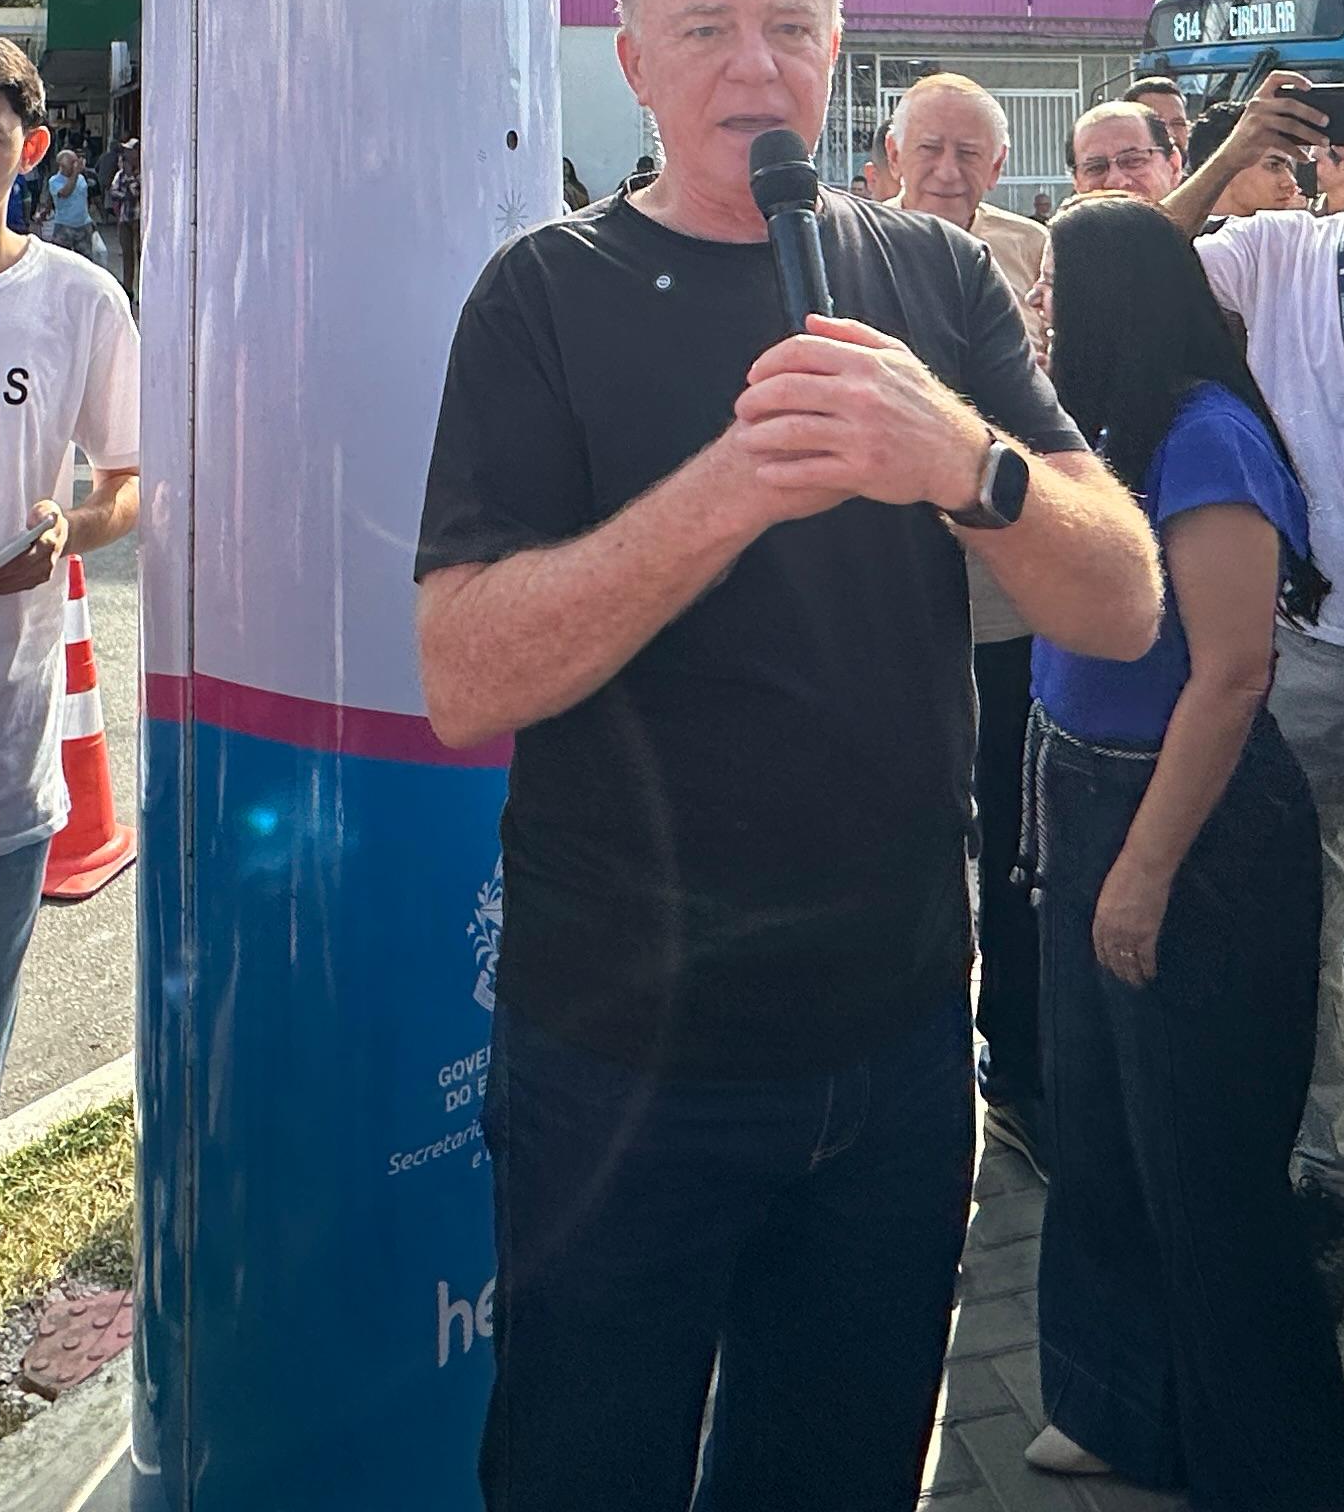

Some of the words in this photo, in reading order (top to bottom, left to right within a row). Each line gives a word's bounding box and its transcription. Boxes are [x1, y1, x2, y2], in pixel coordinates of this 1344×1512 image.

[1173, 11, 1201, 41] 814
[1229, 0, 1296, 37] CIRCULAR
[445, 1084, 471, 1112] DO
